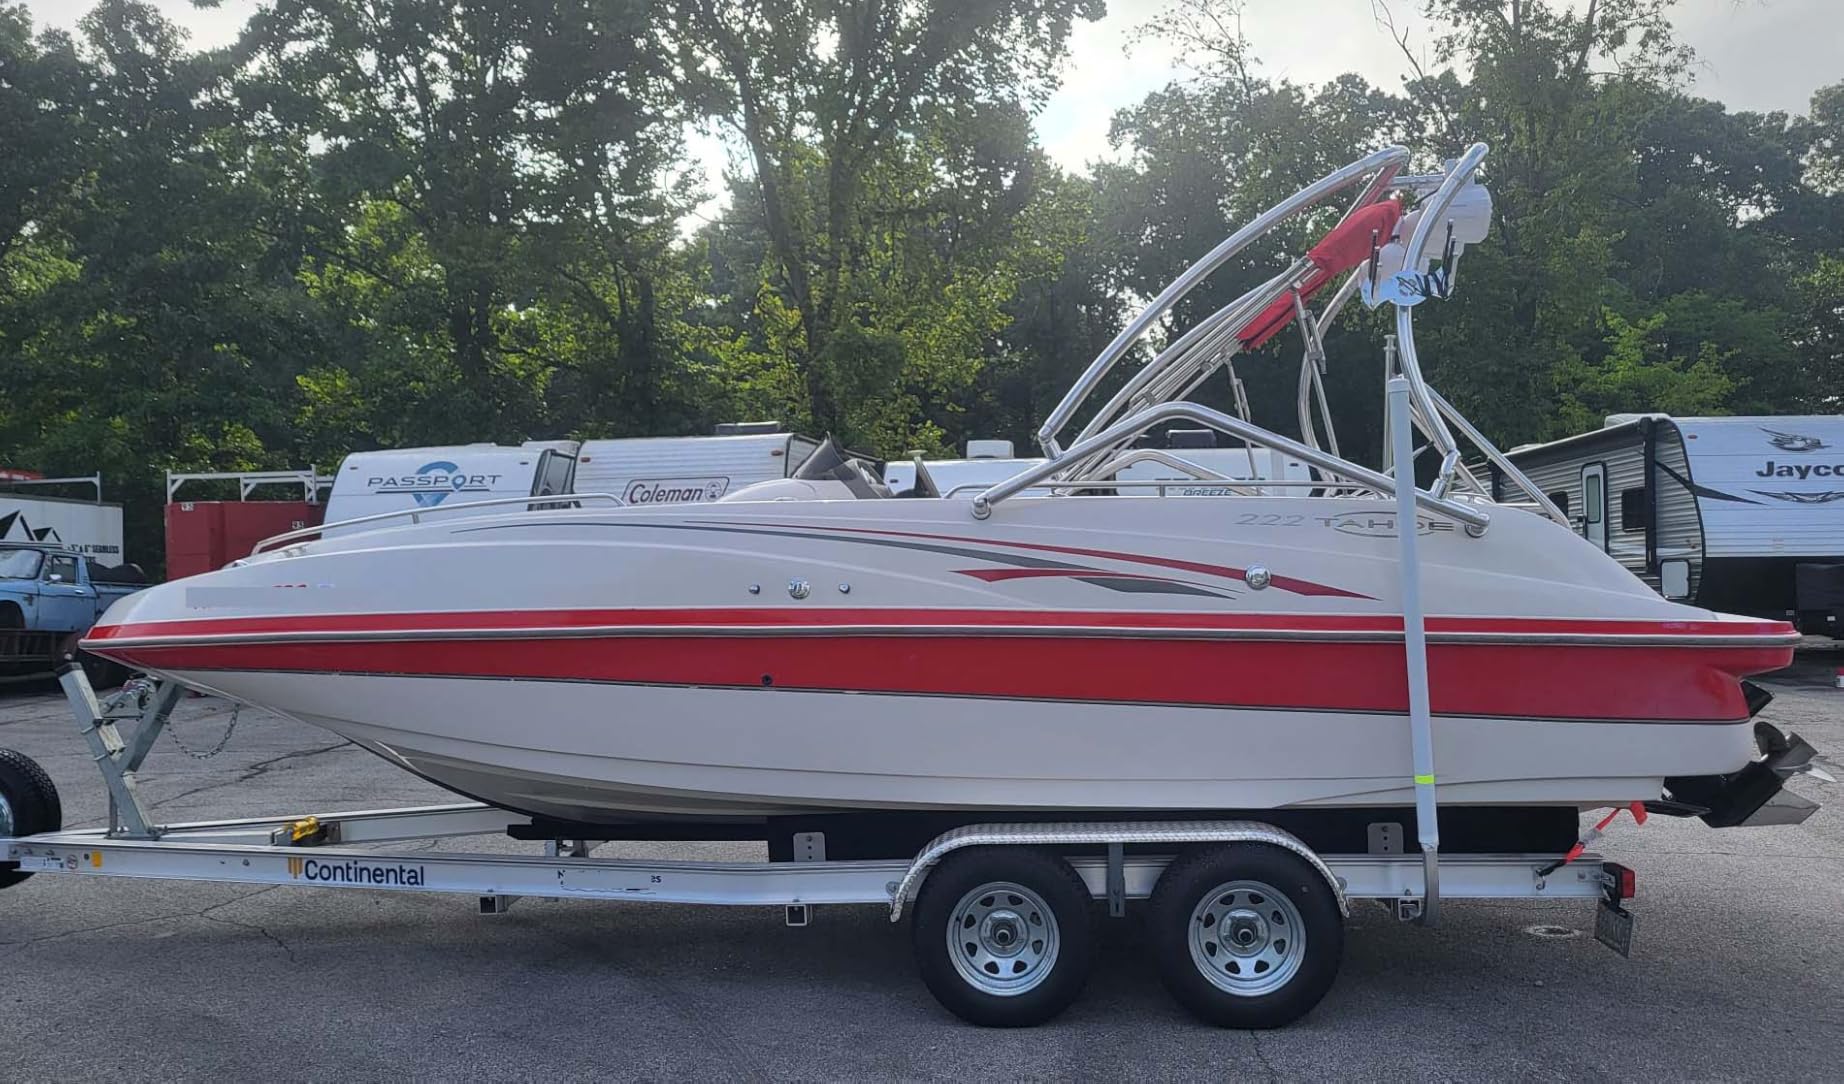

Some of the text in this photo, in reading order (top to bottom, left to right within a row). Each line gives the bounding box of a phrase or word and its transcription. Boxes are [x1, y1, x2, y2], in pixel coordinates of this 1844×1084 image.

[1755, 461, 1844, 480] Jayco
[367, 474, 502, 490] PASSPORT
[629, 483, 703, 504] Coleman
[1233, 513, 1305, 527] 222
[304, 859, 424, 886] Continental
